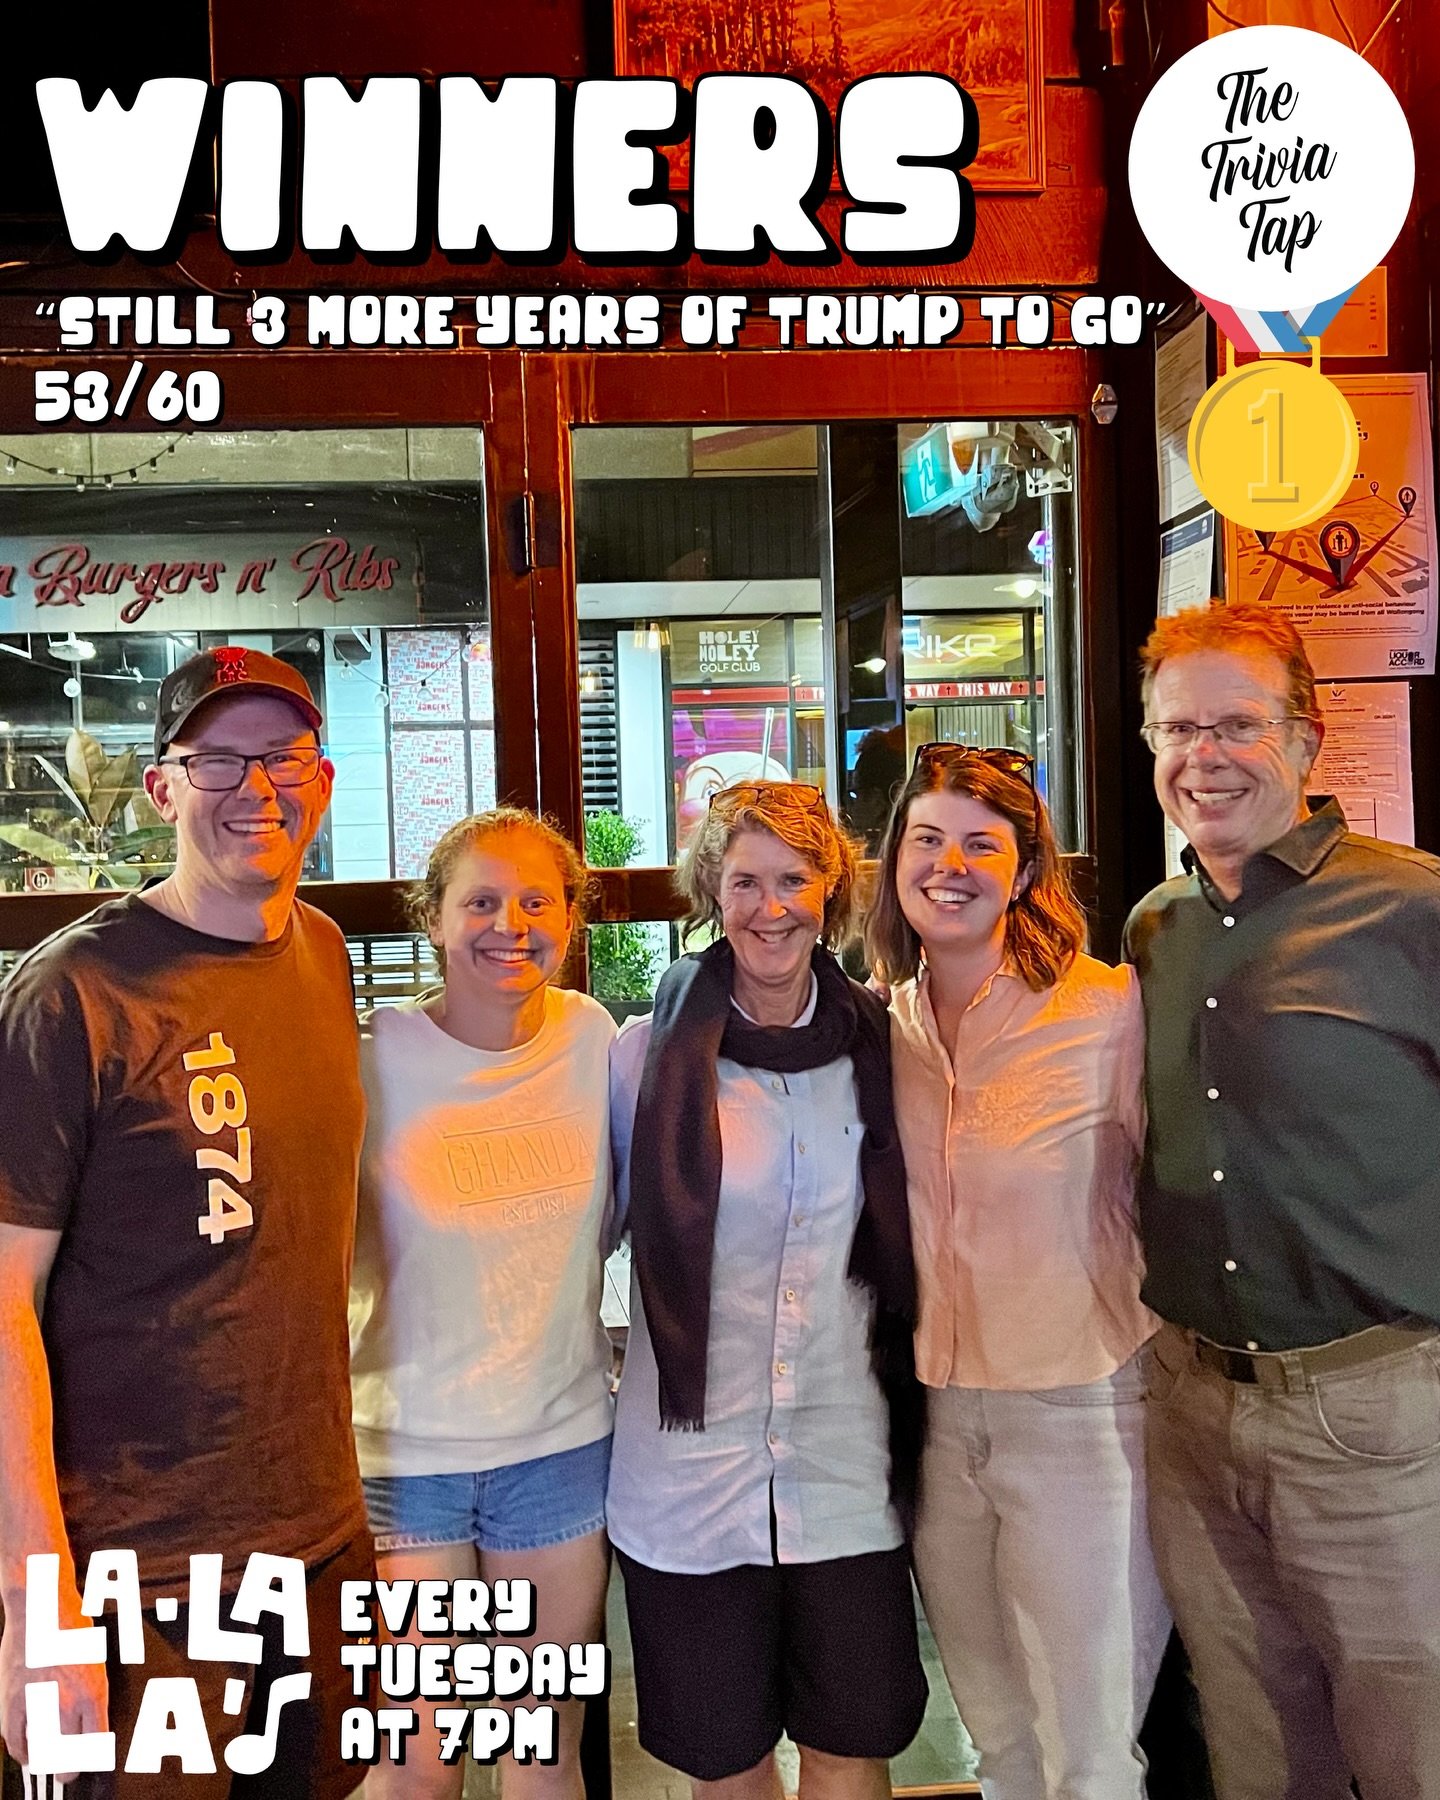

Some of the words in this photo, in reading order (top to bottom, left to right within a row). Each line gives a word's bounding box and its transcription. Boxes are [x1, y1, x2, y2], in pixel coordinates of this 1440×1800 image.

[28, 543, 226, 623] Burgers
[290, 536, 399, 603] Ribs
[698, 629, 760, 645] HOLEY
[698, 644, 760, 662] MOLEY
[699, 662, 730, 673] GOLF
[731, 661, 761, 672] CLUB
[916, 683, 941, 698] WAY
[956, 683, 985, 697] THIS
[988, 682, 1013, 696] WAY
[182, 1031, 254, 1245] 1874
[446, 1124, 596, 1195] GHANDA
